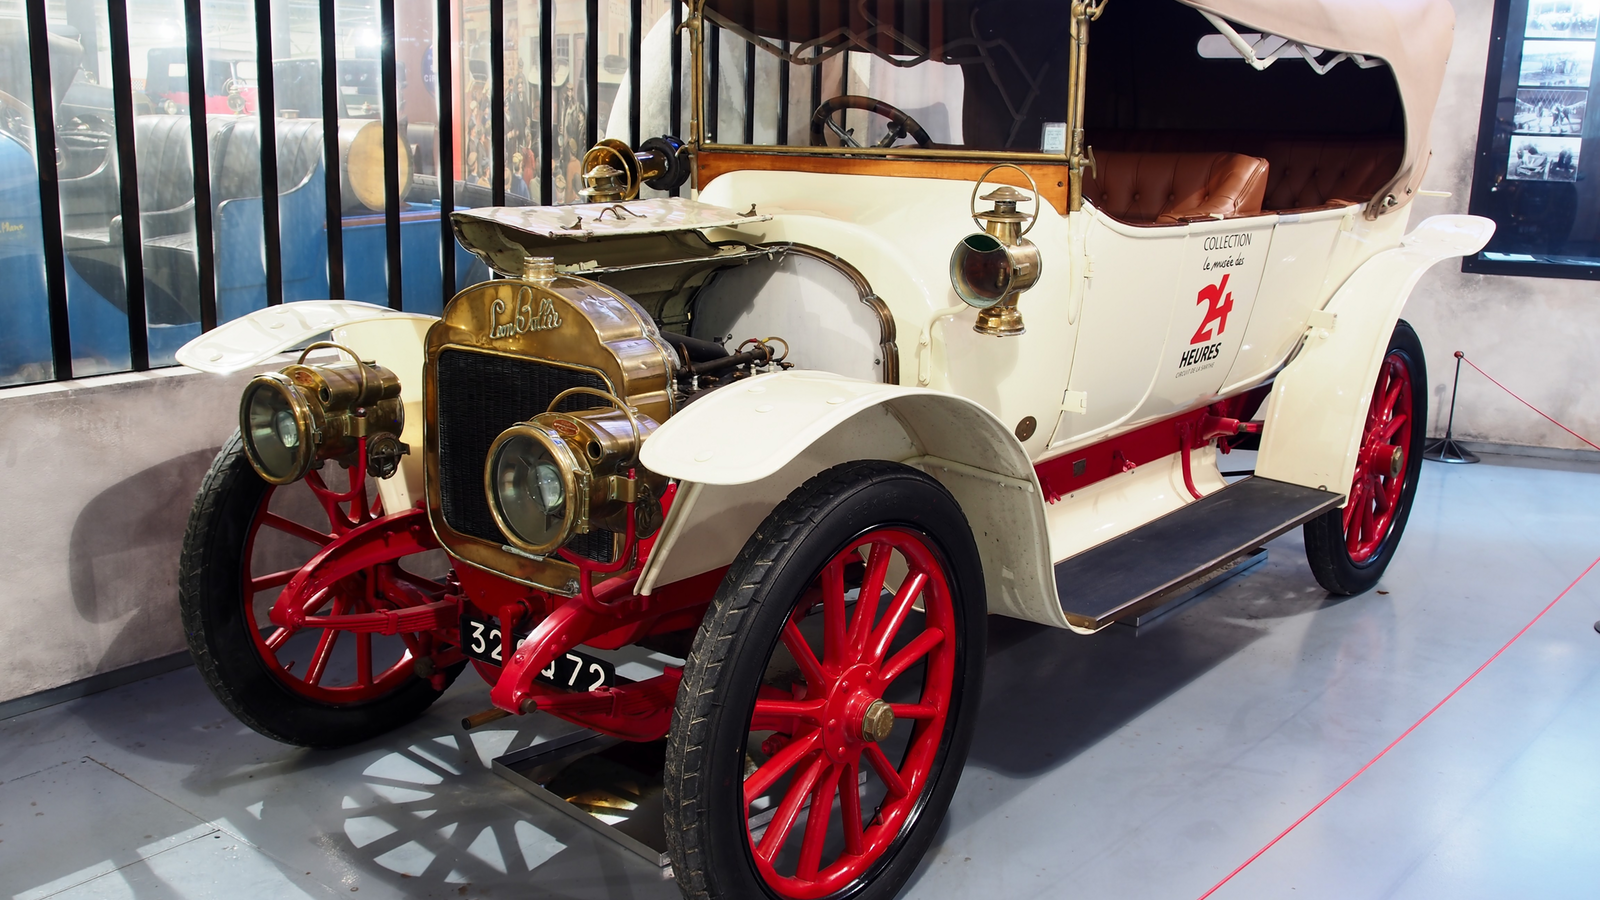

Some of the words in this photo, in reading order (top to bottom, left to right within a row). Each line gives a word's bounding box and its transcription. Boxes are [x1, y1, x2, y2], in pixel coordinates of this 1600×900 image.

[1203, 233, 1252, 251] COLLECTION
[1234, 252, 1245, 266] des
[1190, 273, 1234, 345] 24
[1179, 342, 1222, 369] HEURES
[470, 621, 502, 661] 32
[566, 653, 606, 692] 72
